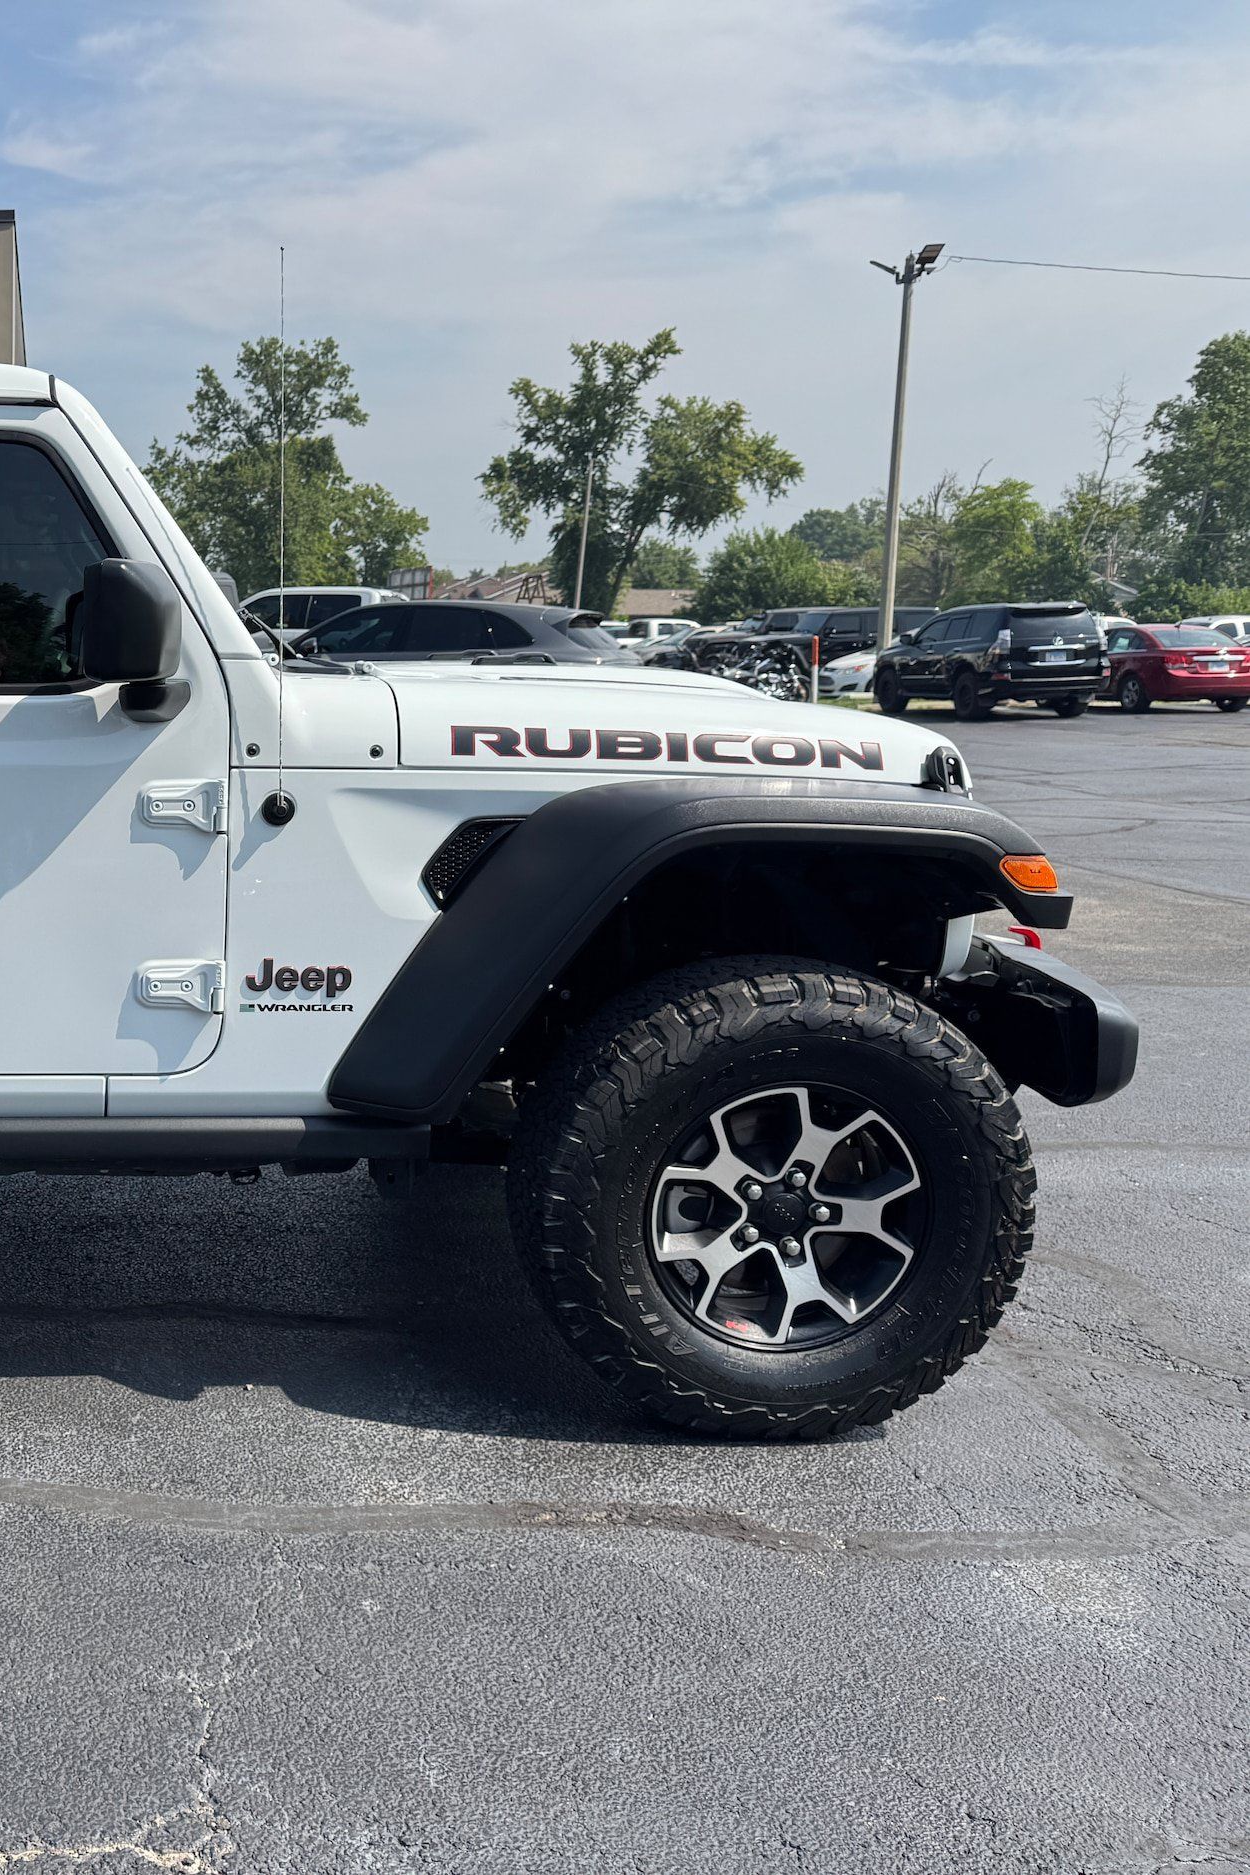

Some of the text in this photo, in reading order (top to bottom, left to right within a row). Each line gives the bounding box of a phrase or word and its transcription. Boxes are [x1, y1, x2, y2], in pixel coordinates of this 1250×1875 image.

[450, 726, 884, 771] RUBICON
[246, 958, 352, 997] Jeep
[257, 1003, 354, 1012] WRANGLER
